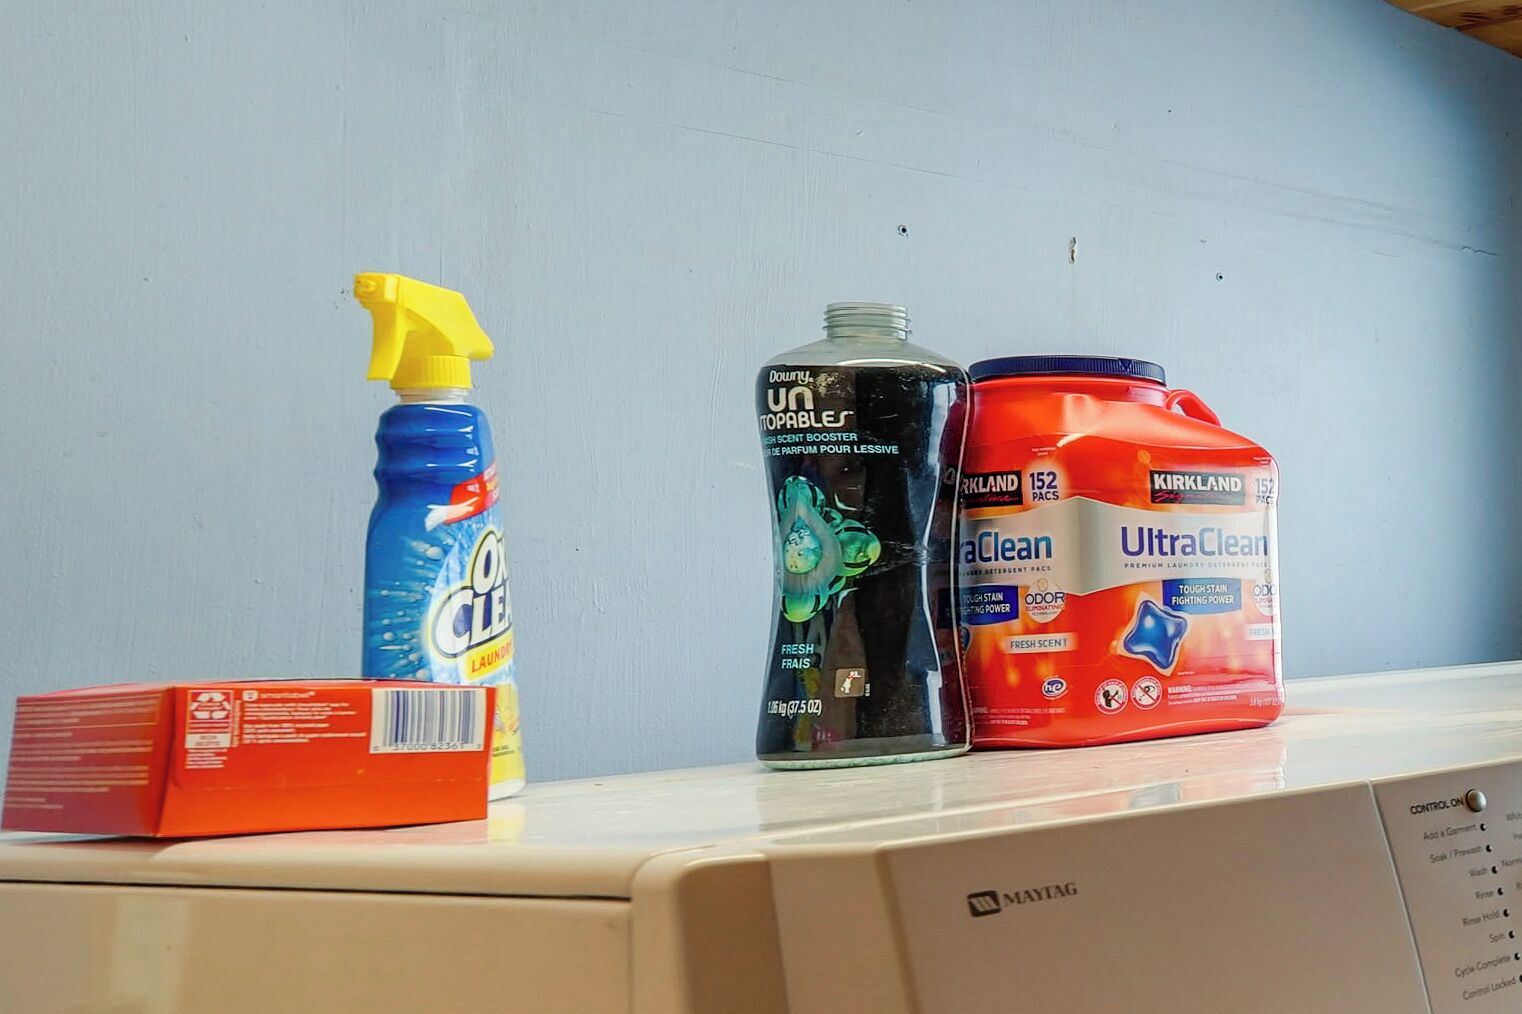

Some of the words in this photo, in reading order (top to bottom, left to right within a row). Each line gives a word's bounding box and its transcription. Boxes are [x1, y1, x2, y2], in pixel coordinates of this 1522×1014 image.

[769, 370, 810, 384] Downy
[777, 434, 804, 444] SCENT
[806, 431, 858, 442] BOOSTER
[772, 448, 781, 456] DE
[781, 445, 818, 455] PARFUM
[820, 445, 851, 454] POUR
[853, 445, 899, 454] LESSIVE
[960, 474, 1018, 494] RKLAND
[1029, 471, 1058, 490] 152
[1153, 473, 1242, 493] KIRKLAND
[1255, 477, 1275, 494] 152
[1032, 490, 1060, 501] PACS
[1121, 526, 1268, 557] UltraClean
[1179, 585, 1206, 594] TOUGH
[1206, 584, 1228, 593] STAIN
[983, 592, 1004, 603] STAIN
[1025, 591, 1065, 605] ODOR
[1172, 596, 1208, 606] FIGHTING
[1209, 595, 1234, 604] POWER
[985, 603, 1011, 614] POWER
[781, 643, 814, 655] FRESH
[1010, 638, 1036, 649] FRESH
[1037, 638, 1067, 648] SCENT
[781, 658, 811, 669] FRAIS
[787, 700, 807, 716] (37.5
[807, 699, 822, 716] OZ)
[1410, 800, 1450, 815] CONTROL
[1450, 797, 1465, 808] ON
[1424, 830, 1438, 841] Add
[1430, 851, 1448, 864] Soak
[1003, 881, 1078, 906] MAYTAG
[1483, 909, 1499, 920] Hold
[1489, 931, 1506, 943] Spin
[1455, 965, 1475, 979] Cycle
[1476, 953, 1511, 972] Complete
[1463, 987, 1490, 1000] Control
[1491, 976, 1517, 991] Locked
